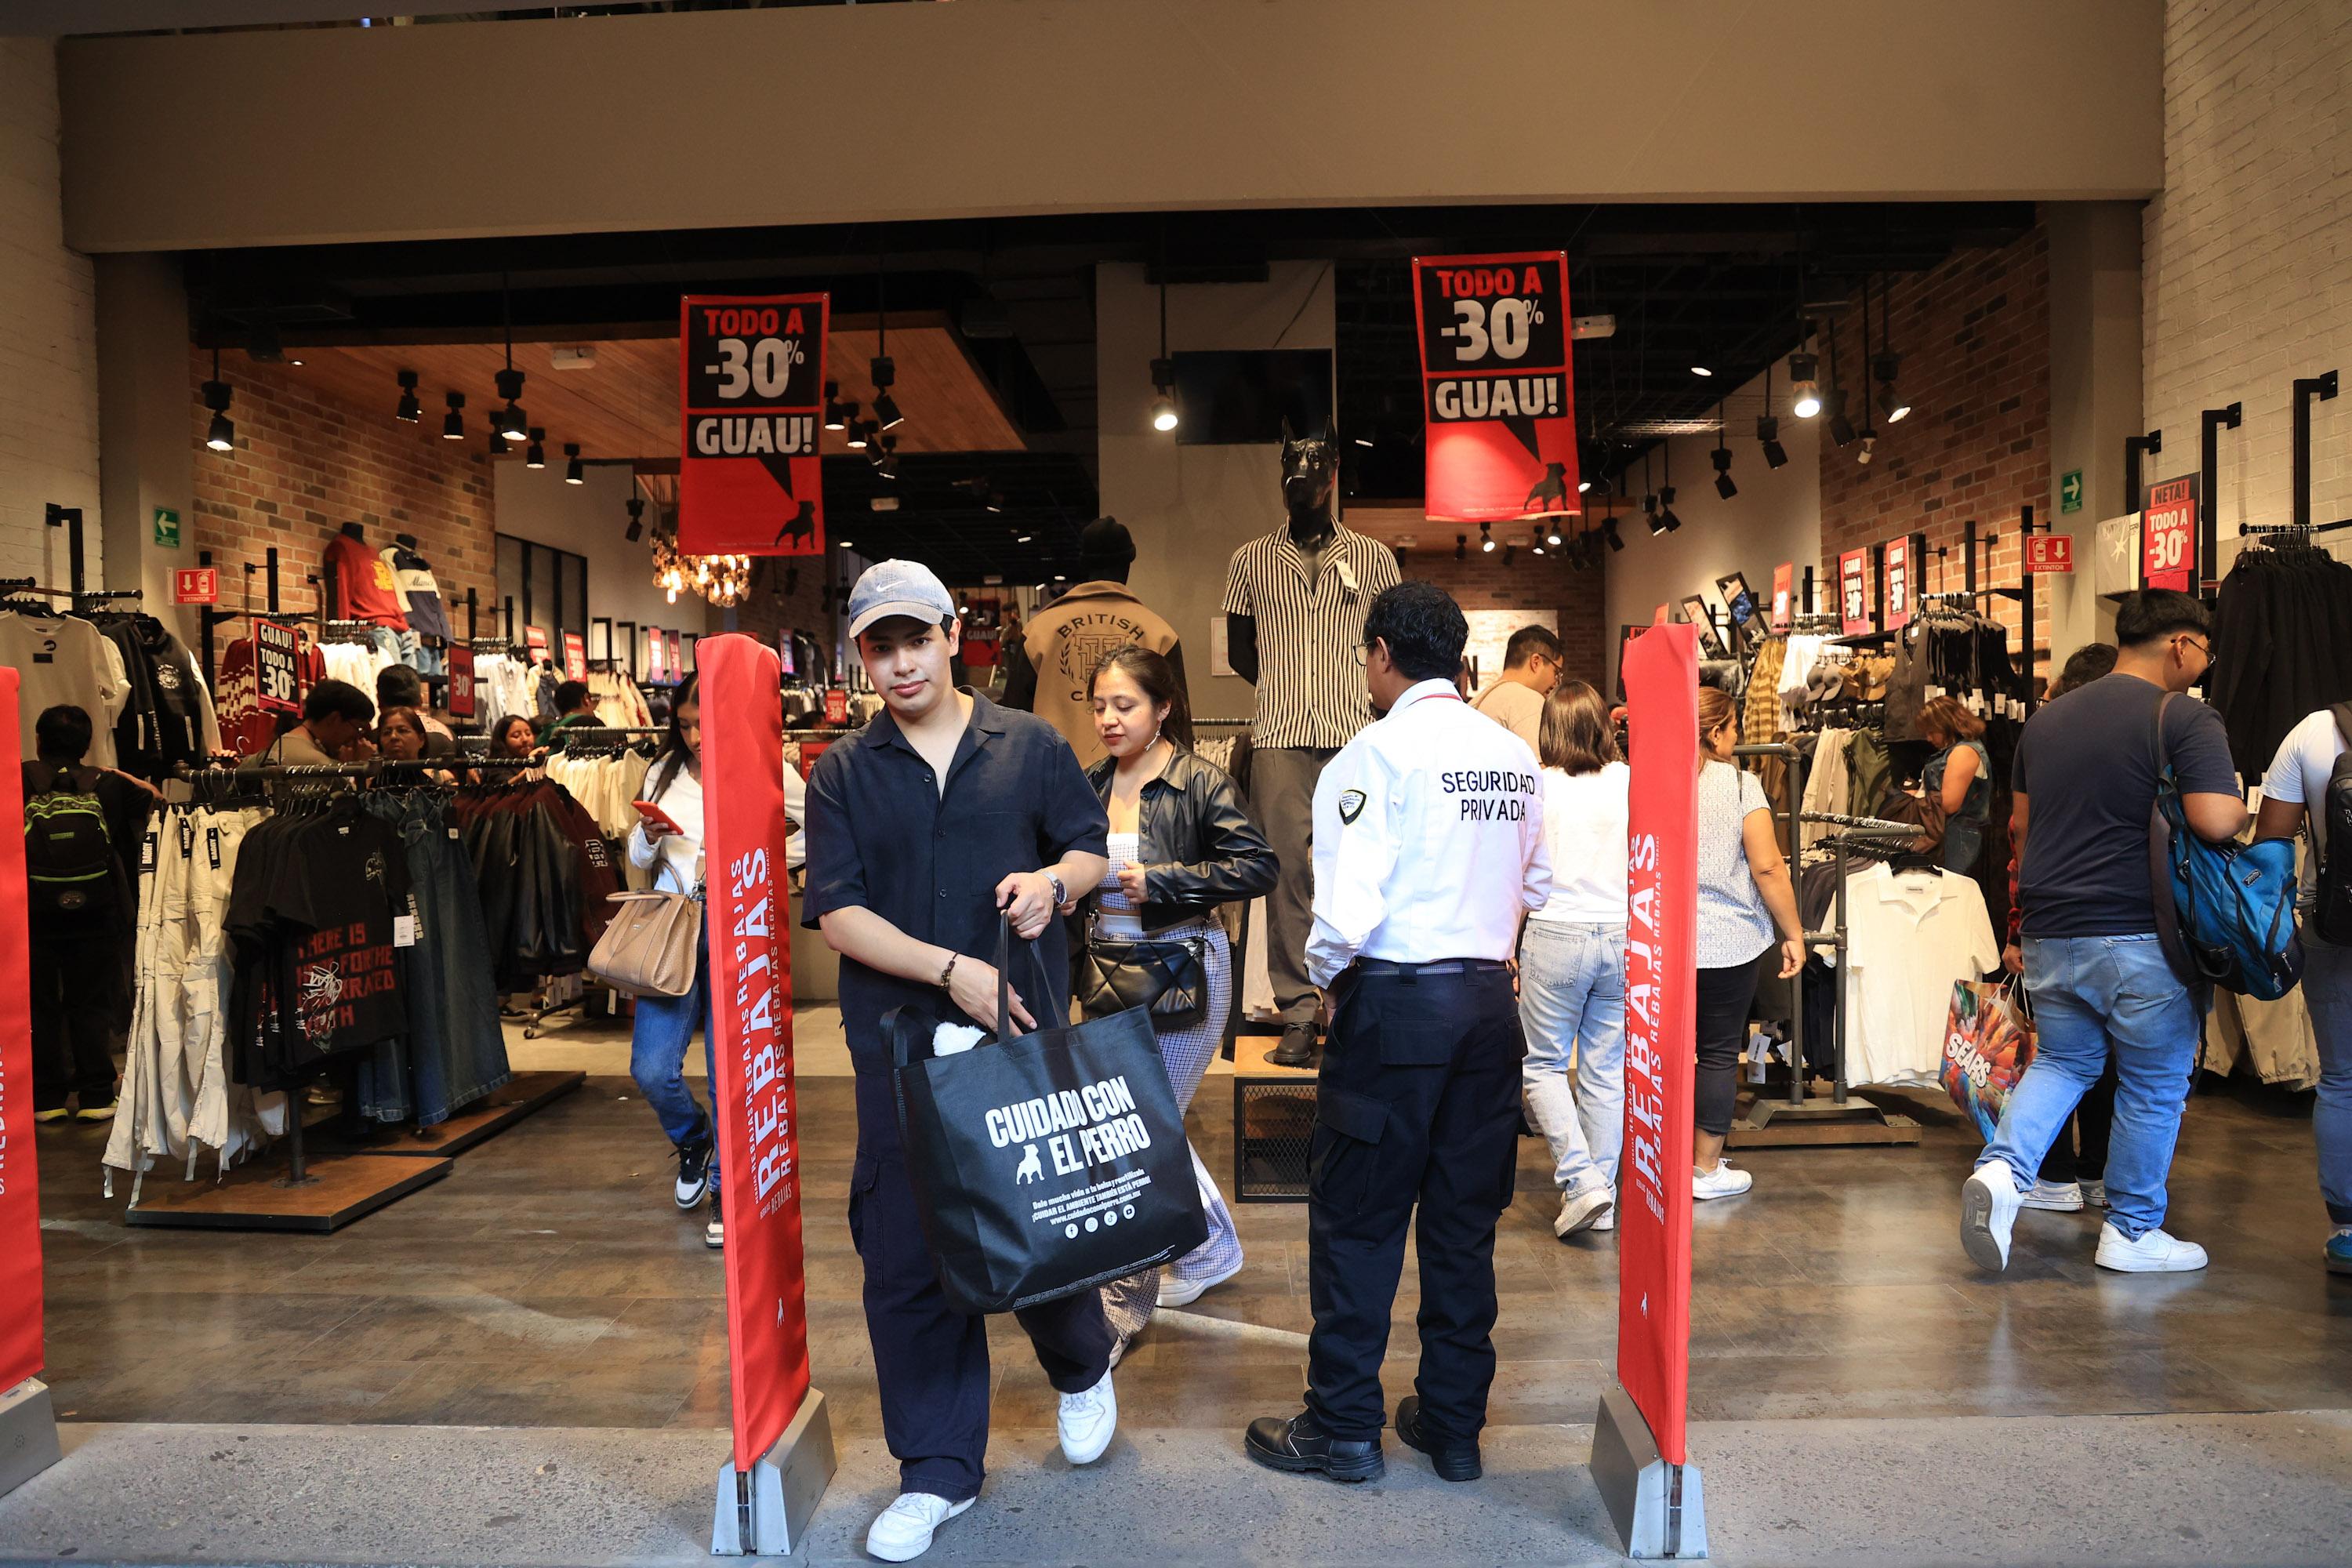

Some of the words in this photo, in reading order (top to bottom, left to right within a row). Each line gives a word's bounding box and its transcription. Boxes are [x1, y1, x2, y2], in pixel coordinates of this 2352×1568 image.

[1436, 268, 1515, 297] TODO
[1523, 267, 1543, 294] A
[703, 309, 779, 336] TODO
[785, 307, 804, 335] A
[1441, 298, 1544, 361] -30%
[706, 337, 804, 399] -30%
[1435, 377, 1559, 419] GUAU!
[696, 417, 813, 455] GUAU!
[2155, 485, 2186, 505] NETA!
[2150, 510, 2178, 532] TODO
[2180, 507, 2188, 526] A
[2149, 528, 2188, 568] -30%
[260, 624, 292, 650] GUAU!
[1057, 613, 1145, 641] BRITISH
[260, 648, 285, 669] TODO
[287, 656, 294, 671] A
[1441, 771, 1535, 795] SEGURIDAD
[1461, 799, 1526, 822] PRIVADA
[142, 842, 153, 865] BAGGY
[731, 858, 748, 1007] REBAJAS
[770, 946, 782, 1036] REBAJAS
[1630, 833, 1656, 1185] REBAJAS
[1650, 943, 1662, 1044] REBAJAS
[742, 848, 781, 1200] REBAJAS
[742, 1007, 753, 1107] REBAJAS
[1946, 1033, 1992, 1088] SEARS
[775, 1044, 792, 1178] REBAJAS
[985, 1089, 1088, 1149] CUIDADO
[1081, 1076, 1136, 1122] CON
[1650, 1051, 1663, 1198] REBAJAS
[747, 1107, 757, 1174] REBAJAS
[1047, 1134, 1084, 1176] EL
[1079, 1113, 1152, 1167] PERRO
[771, 1182, 793, 1215] REBAJAS
[1032, 1207, 1058, 1223] ¡CUIDAR
[1058, 1204, 1067, 1214] EL
[1066, 1196, 1096, 1211] AMBIENTE
[1033, 1200, 1047, 1210] Dale
[1047, 1193, 1071, 1205] mucha
[1071, 1189, 1085, 1198] vida
[1090, 1185, 1097, 1193] tu
